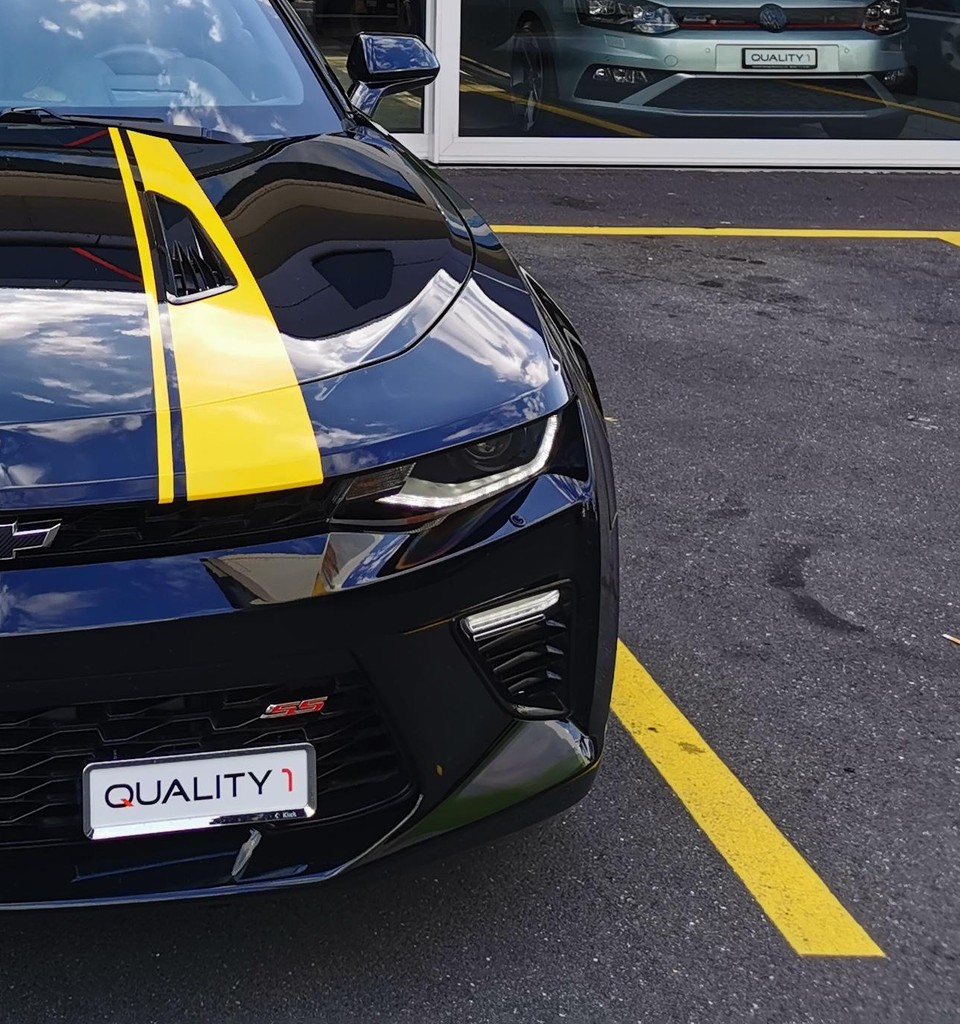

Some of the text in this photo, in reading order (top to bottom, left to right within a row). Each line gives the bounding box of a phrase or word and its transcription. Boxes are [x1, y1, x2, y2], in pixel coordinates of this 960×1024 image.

[751, 53, 804, 62] QUALITY
[260, 696, 329, 719] SS
[104, 768, 293, 809] QUALITY 1
